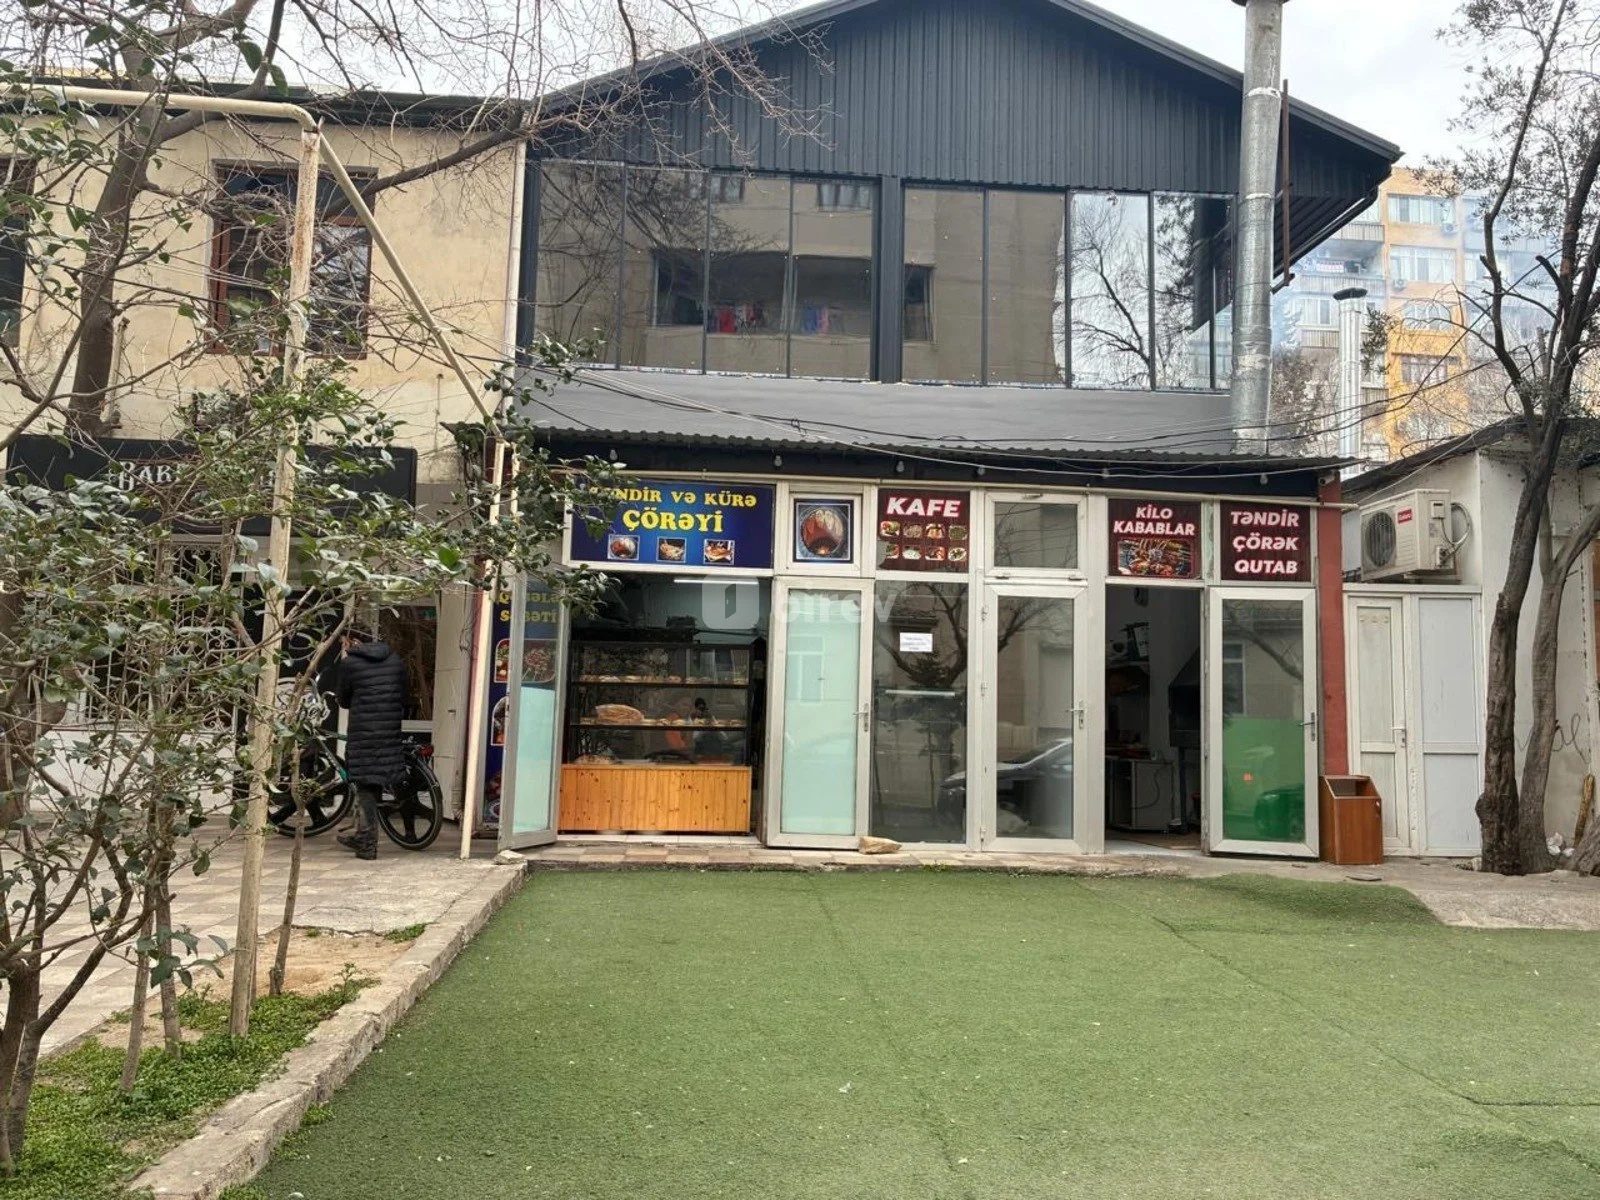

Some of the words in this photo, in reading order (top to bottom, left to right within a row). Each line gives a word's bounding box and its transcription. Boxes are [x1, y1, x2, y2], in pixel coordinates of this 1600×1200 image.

[590, 486, 662, 503] NDİR
[670, 491, 696, 504] VƏ
[704, 490, 757, 508] KÜRƏ
[886, 497, 961, 518] KAFE
[1135, 504, 1173, 520] KİLO
[622, 507, 724, 533] ÇÖRƏYİ
[1113, 520, 1196, 537] KABABLAR
[1230, 509, 1300, 528] TƏNDİR
[1232, 532, 1300, 553] ÇÖRƏK
[1234, 559, 1298, 575] QUTAB
